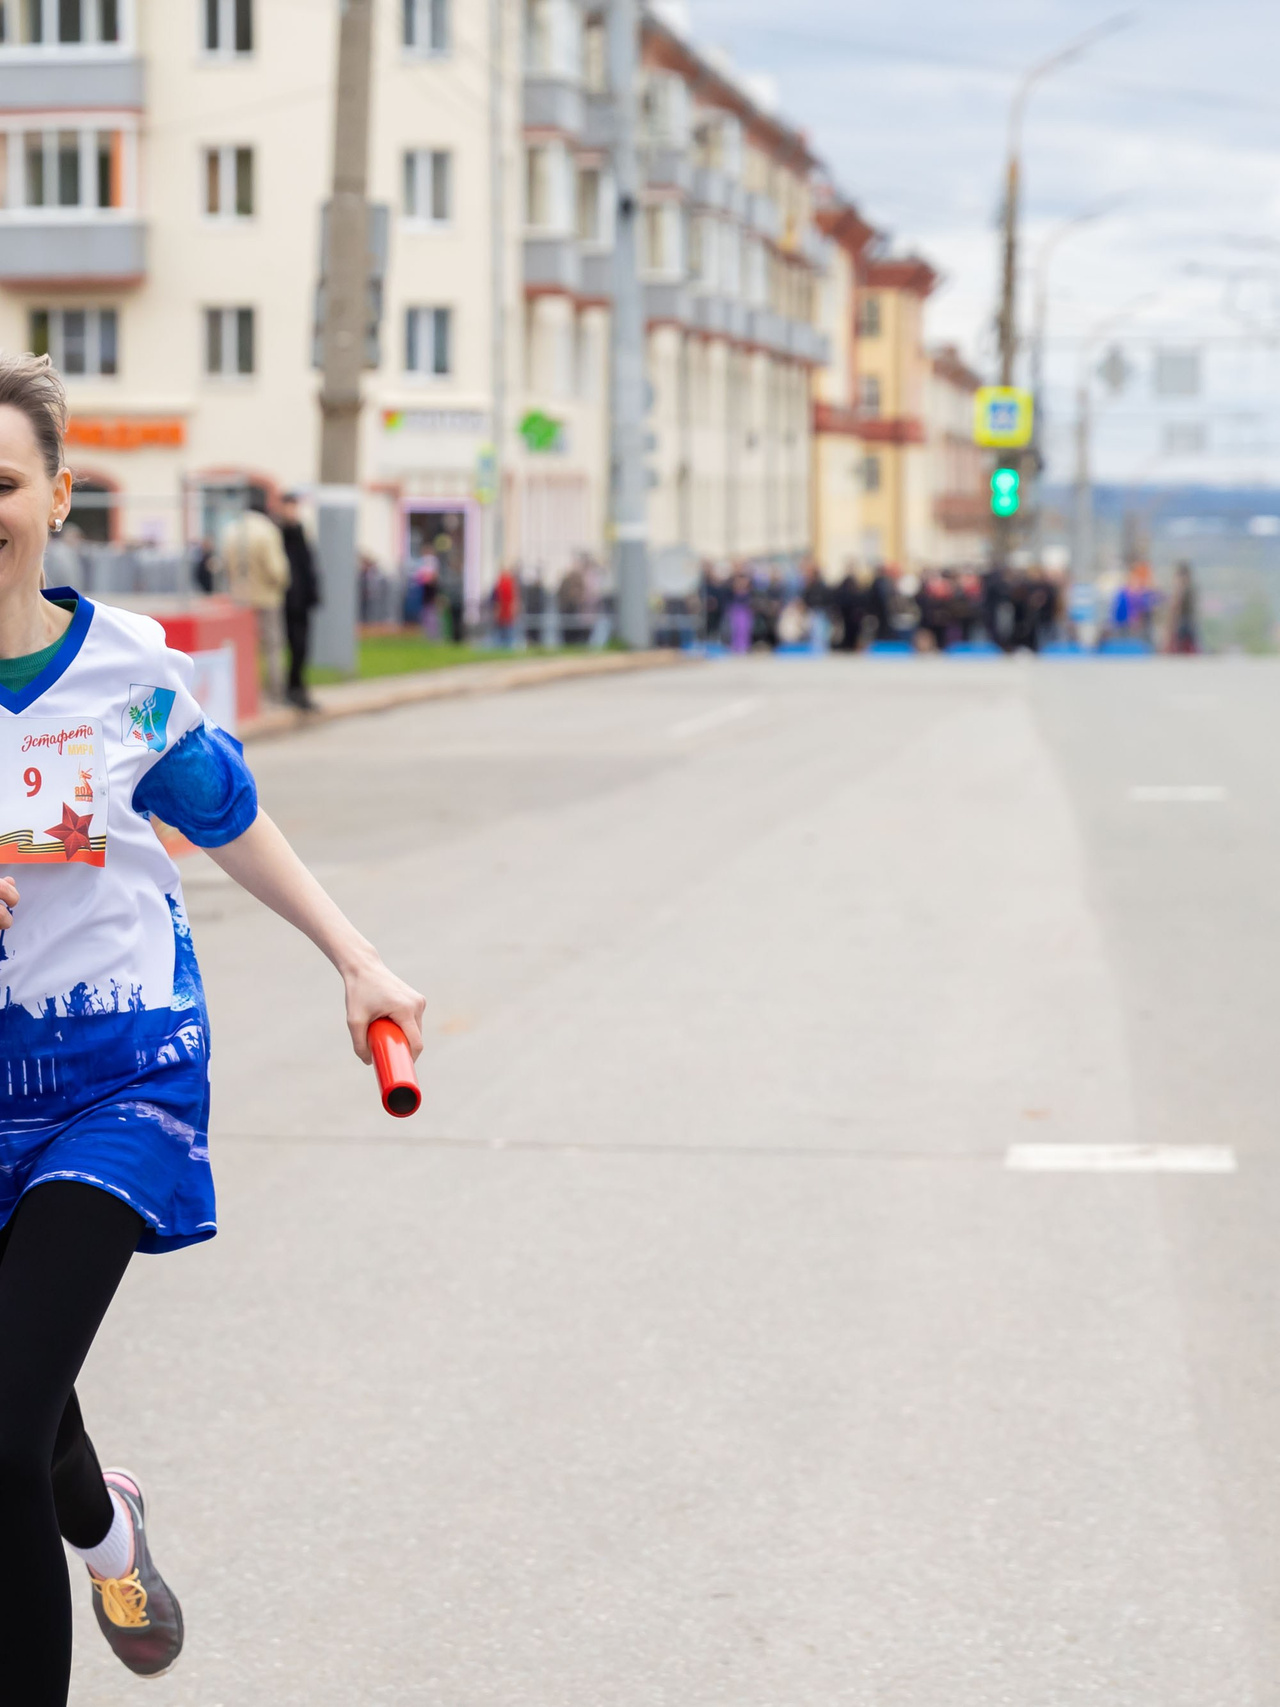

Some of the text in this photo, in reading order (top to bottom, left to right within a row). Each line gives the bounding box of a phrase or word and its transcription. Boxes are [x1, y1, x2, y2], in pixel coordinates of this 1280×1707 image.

[21, 724, 94, 756] Эстафета
[68, 744, 94, 756] МИРА
[23, 767, 42, 797] 9
